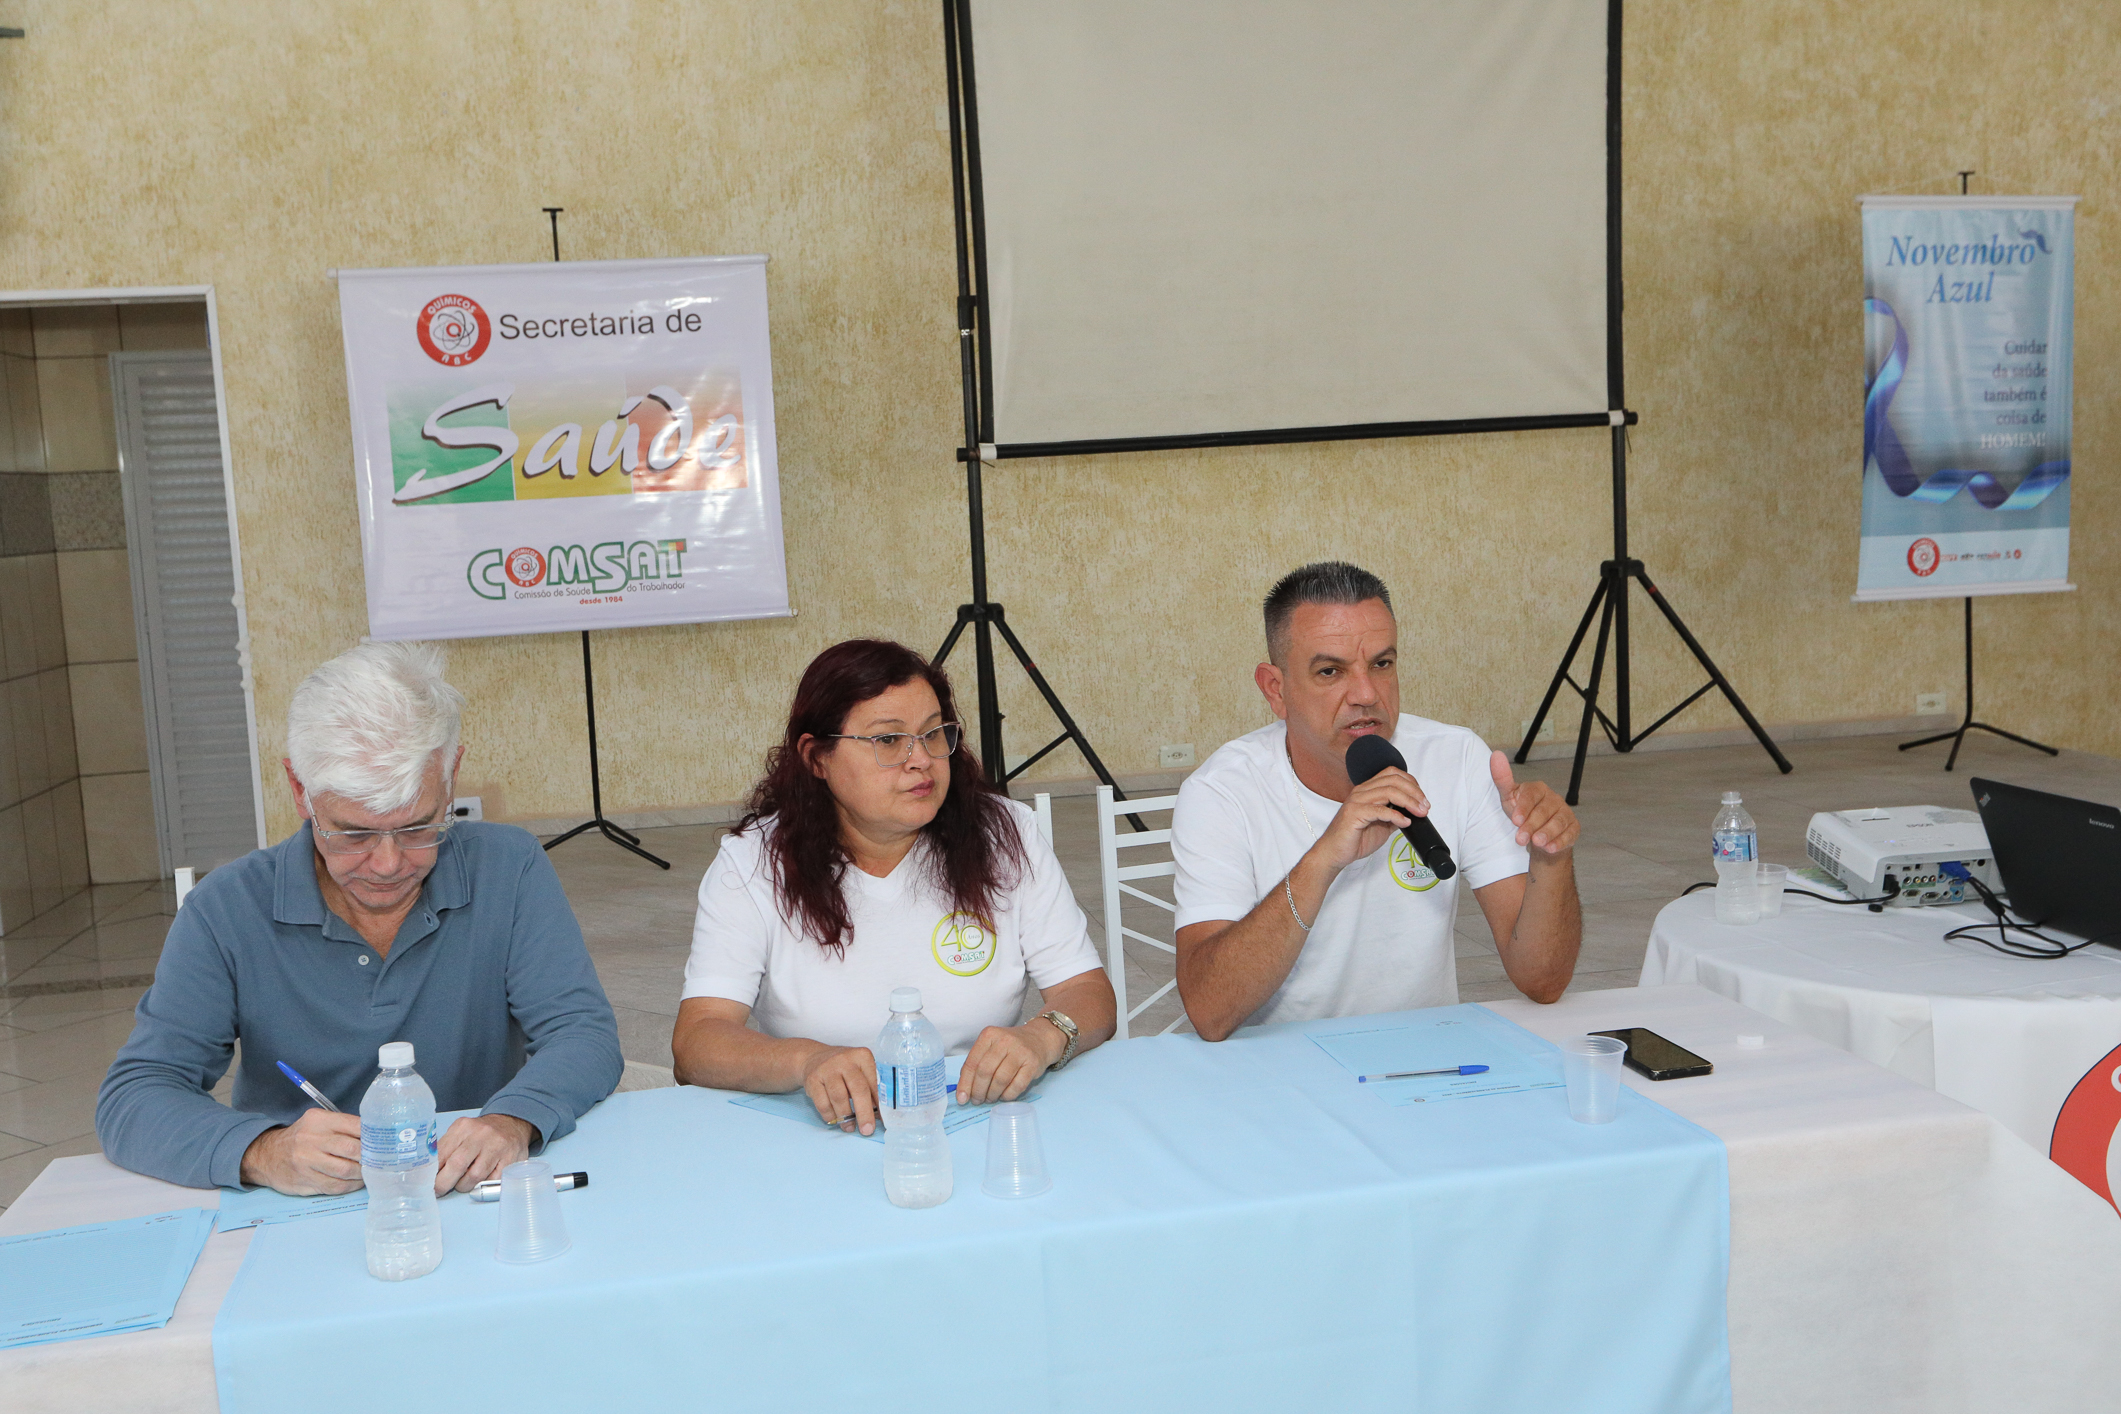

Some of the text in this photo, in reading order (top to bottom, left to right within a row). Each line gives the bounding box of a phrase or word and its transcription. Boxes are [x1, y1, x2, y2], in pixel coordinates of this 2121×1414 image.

[1885, 233, 2036, 266] Novembro
[1926, 270, 1995, 303] Azul
[500, 309, 702, 340] Secretaria de
[2004, 339, 2047, 355] Cuidar
[1992, 362, 2047, 378] da saúde
[1984, 385, 2047, 401] também é
[1996, 408, 2047, 425] coisa de
[391, 383, 742, 505] Saúde
[1980, 431, 2046, 449] HOMEM!
[467, 540, 687, 600] COMSAT
[514, 580, 685, 600] Comissão de Saúde do Trabalhador
[579, 595, 623, 605] desde 1984
[941, 924, 984, 952] 40
